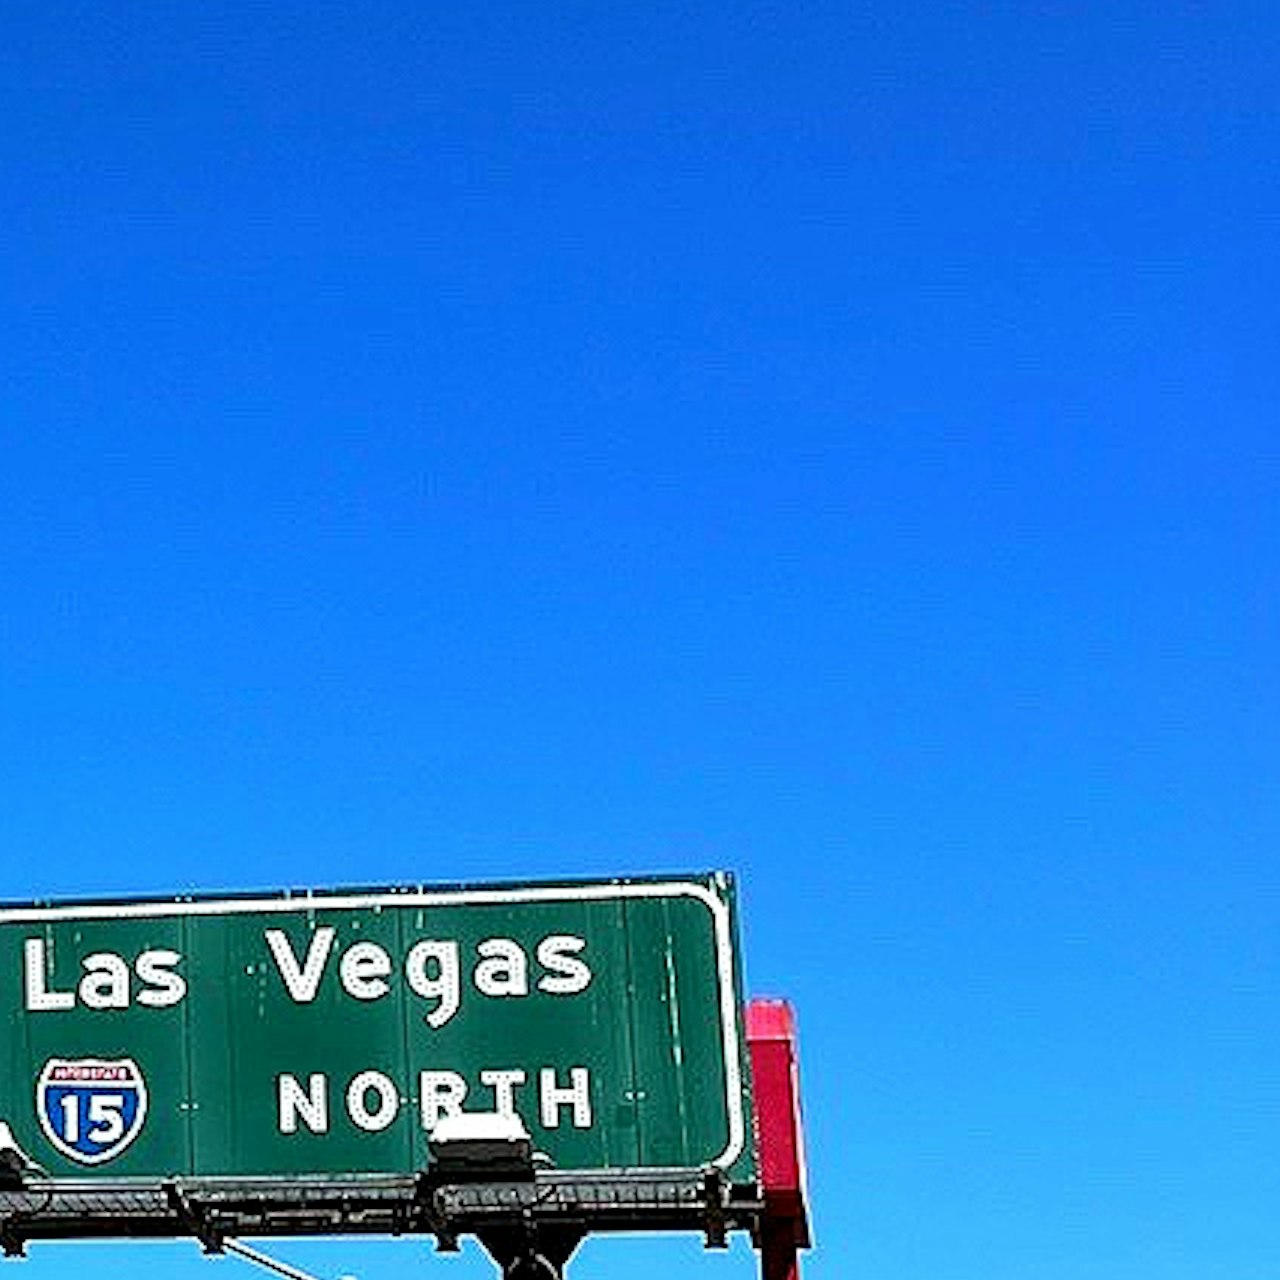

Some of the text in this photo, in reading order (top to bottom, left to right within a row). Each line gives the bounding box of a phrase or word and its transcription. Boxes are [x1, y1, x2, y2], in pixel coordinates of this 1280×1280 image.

[24, 926, 592, 1029] Las Vegas
[60, 1093, 124, 1143] 15
[278, 1068, 592, 1134] NORTH
